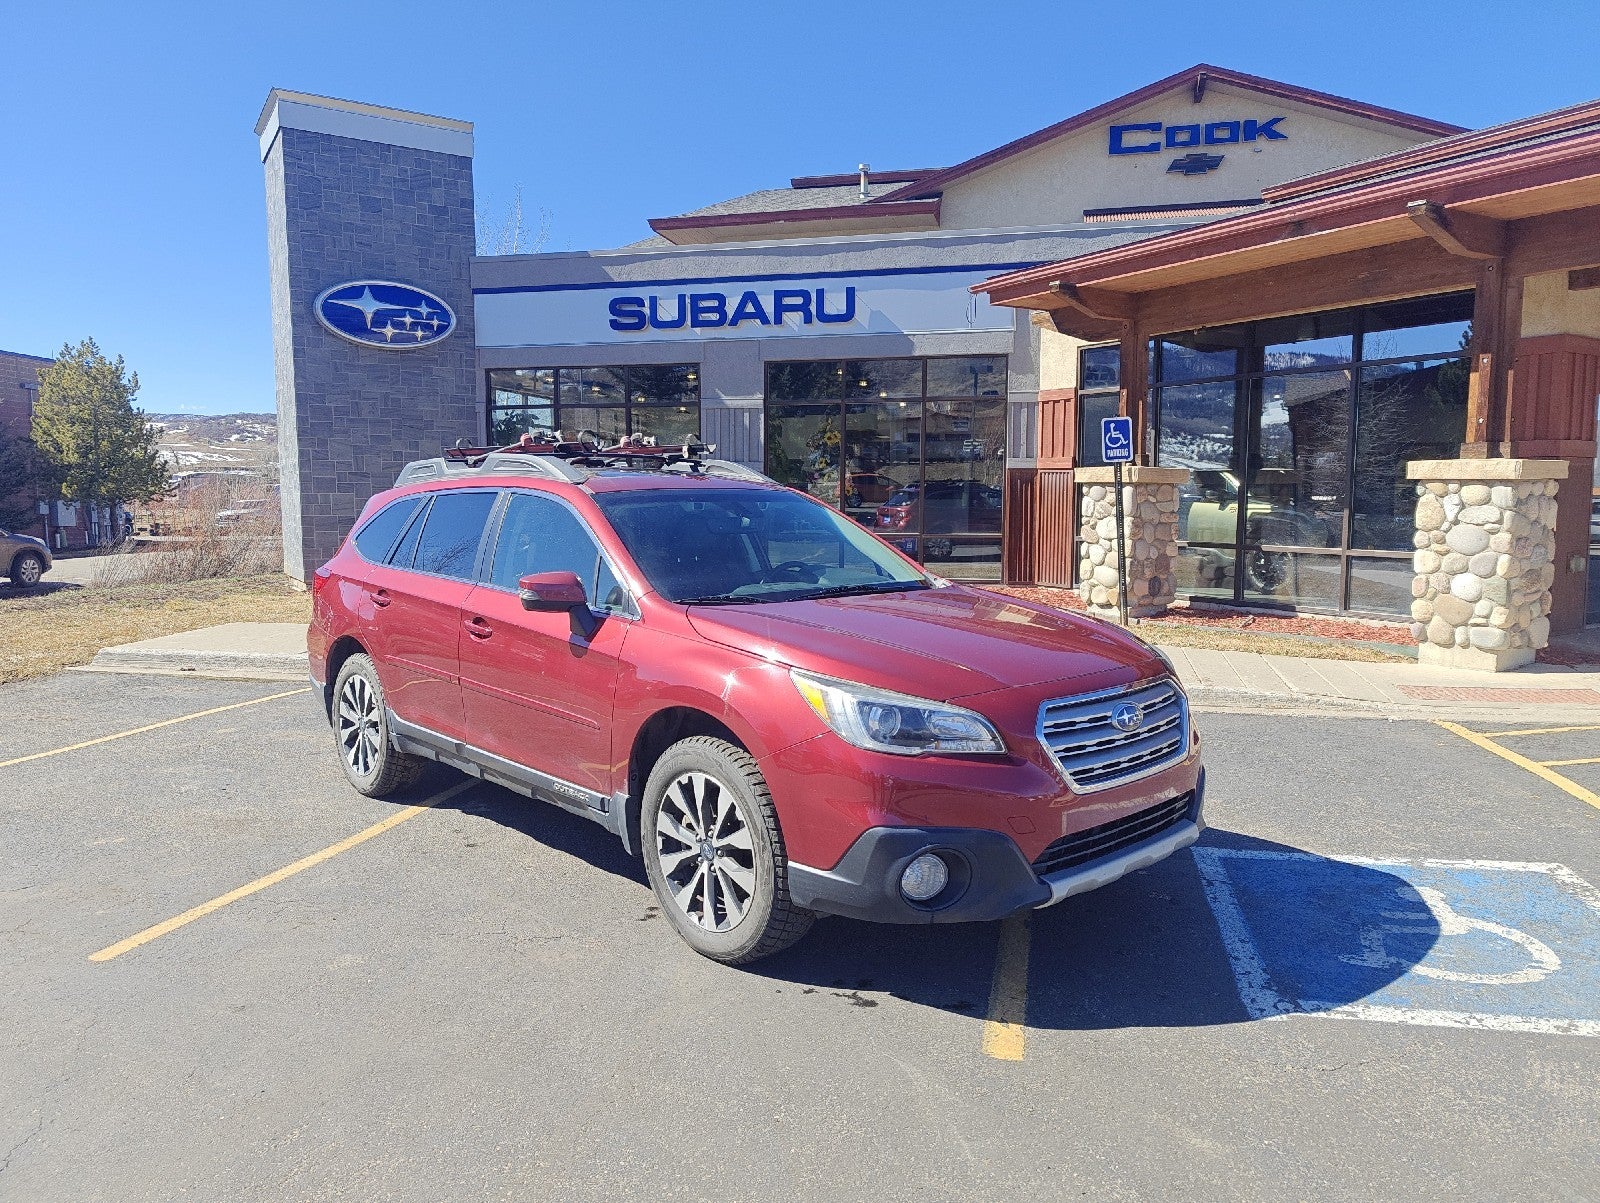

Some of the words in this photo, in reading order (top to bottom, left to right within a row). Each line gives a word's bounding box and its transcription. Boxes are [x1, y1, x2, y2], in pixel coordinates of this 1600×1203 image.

[1108, 117, 1288, 155] COOK
[608, 287, 856, 331] SUBARU
[1106, 448, 1129, 457] PARKING
